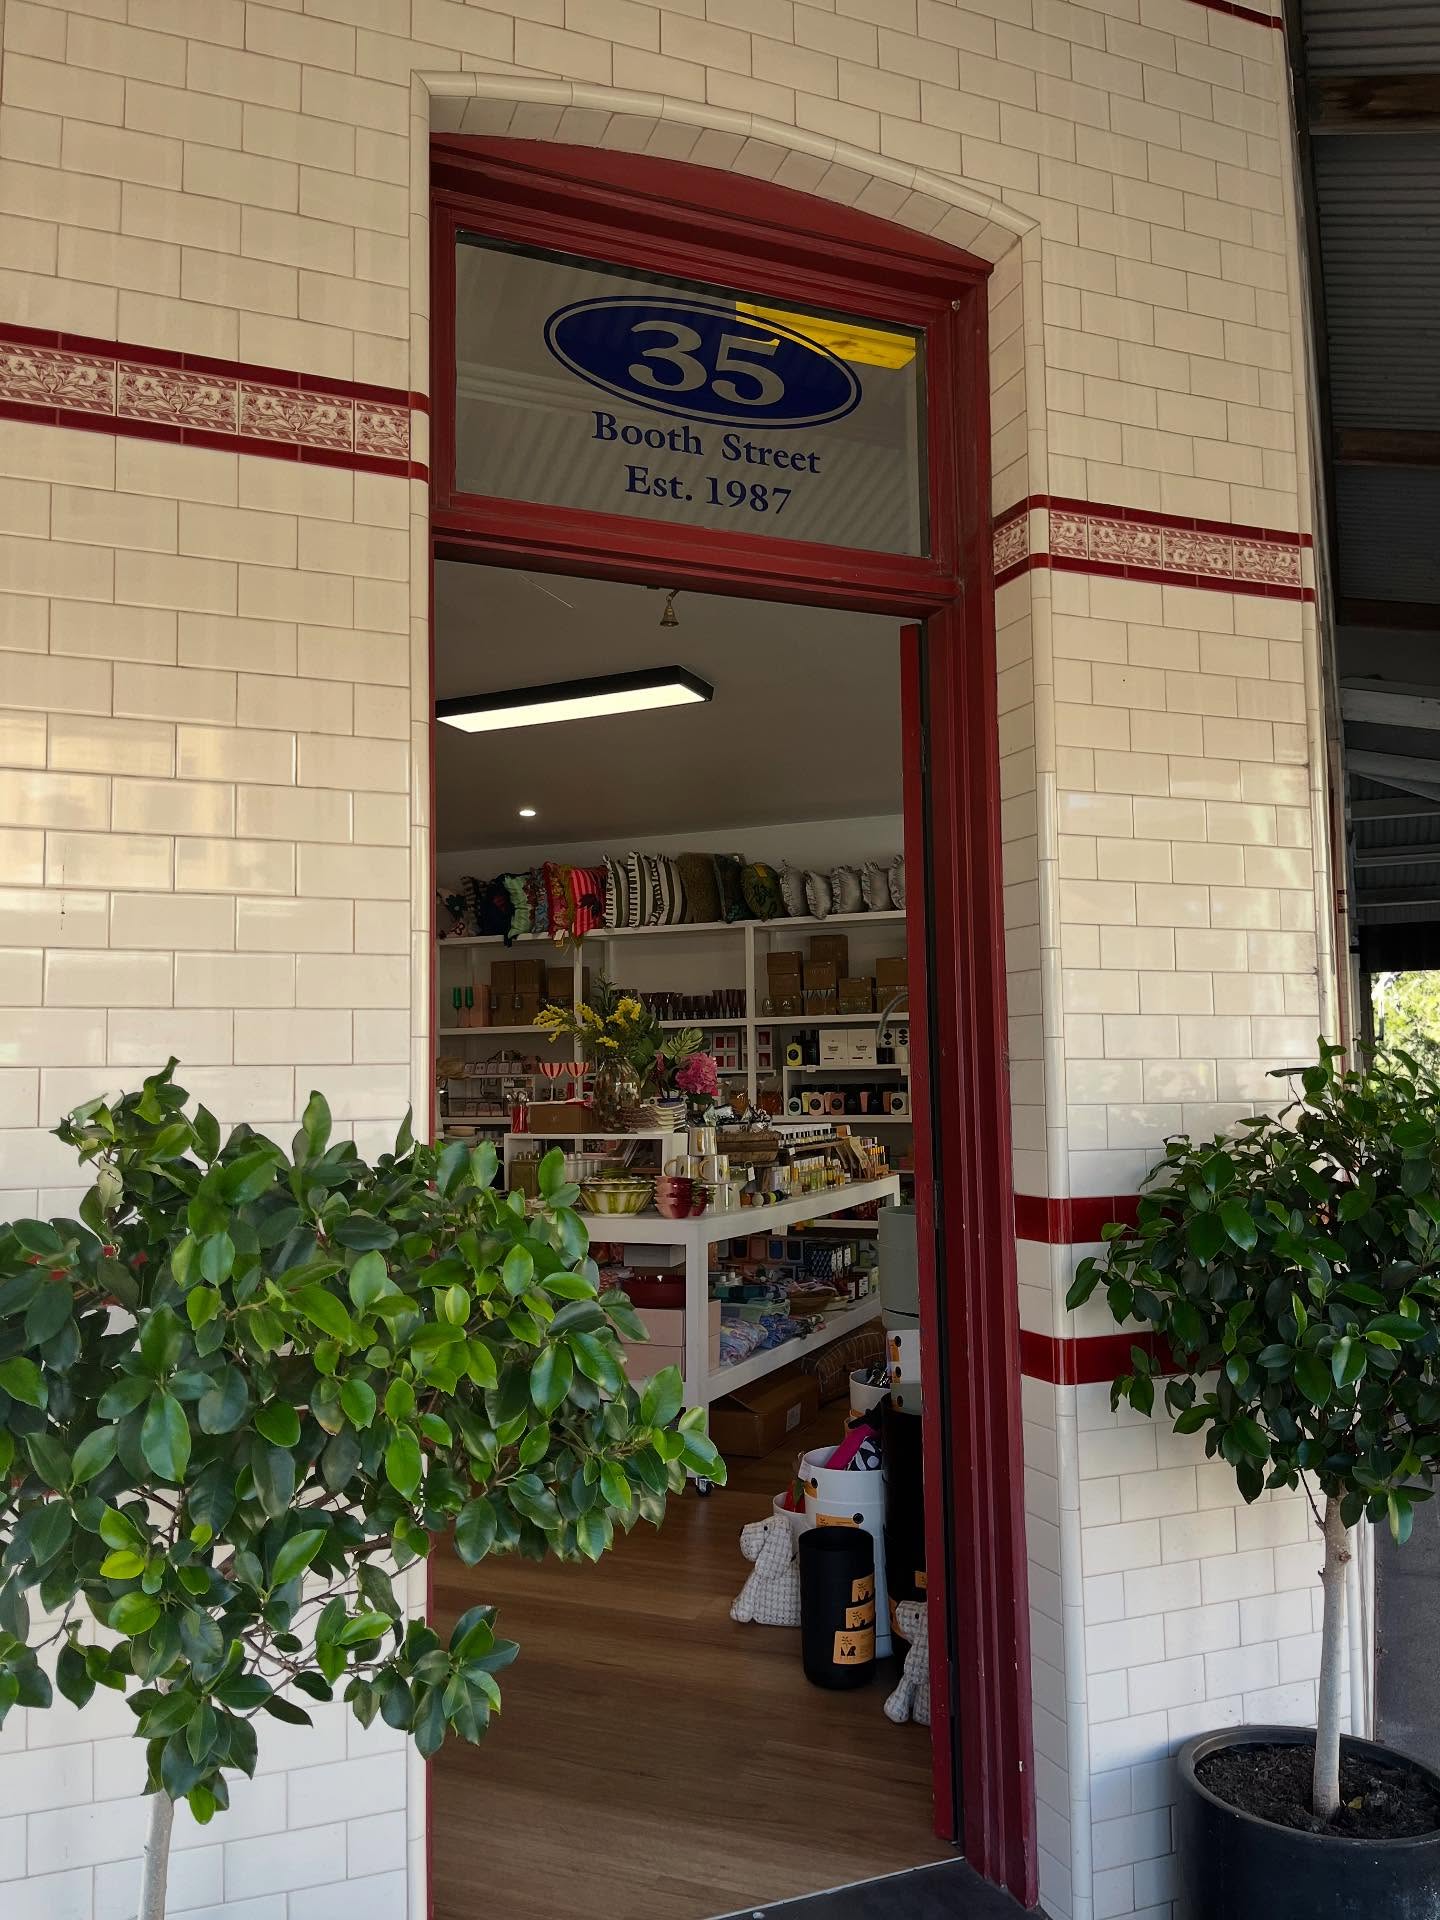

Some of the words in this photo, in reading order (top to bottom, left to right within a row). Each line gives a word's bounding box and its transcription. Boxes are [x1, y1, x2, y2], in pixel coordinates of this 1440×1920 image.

[628, 320, 785, 406] 35
[591, 410, 704, 455] Booth
[721, 433, 821, 474] Street
[624, 464, 693, 502] Est.
[706, 476, 792, 514] 1987
